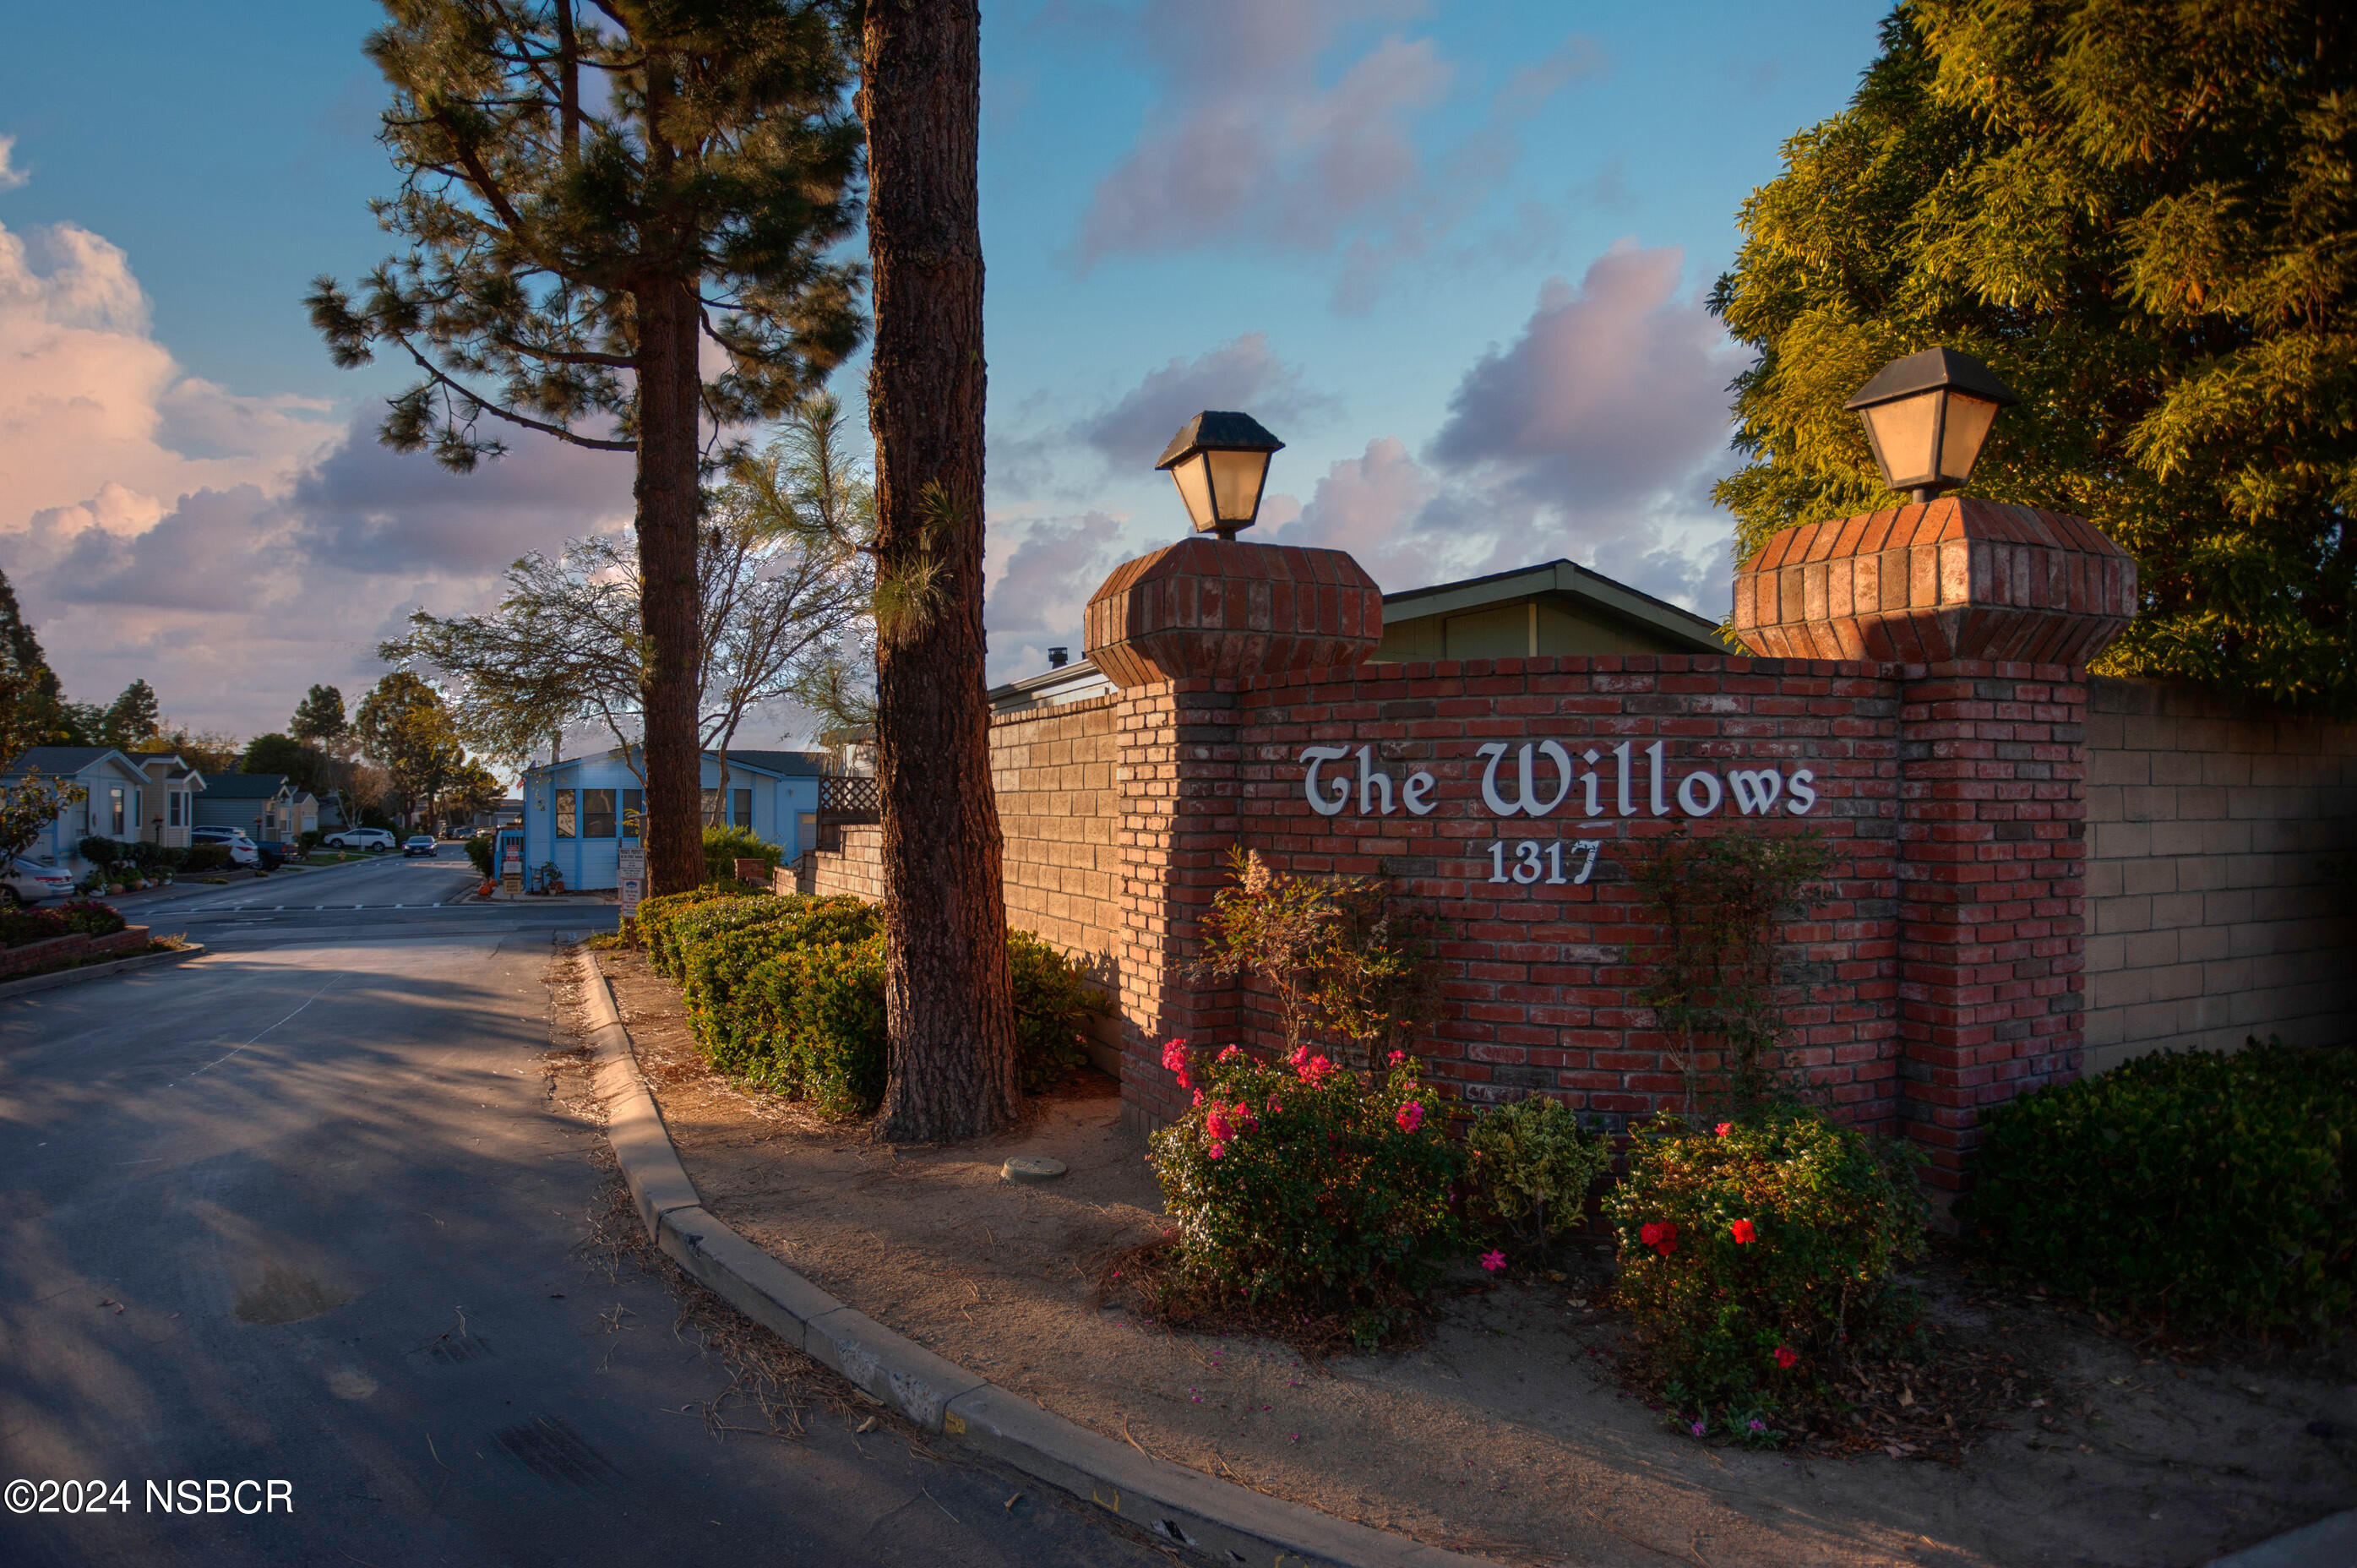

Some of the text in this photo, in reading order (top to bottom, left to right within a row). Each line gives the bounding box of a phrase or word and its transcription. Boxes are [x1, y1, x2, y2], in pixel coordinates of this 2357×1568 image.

[1299, 740, 1816, 817] The Willows
[1488, 840, 1600, 885] 1317
